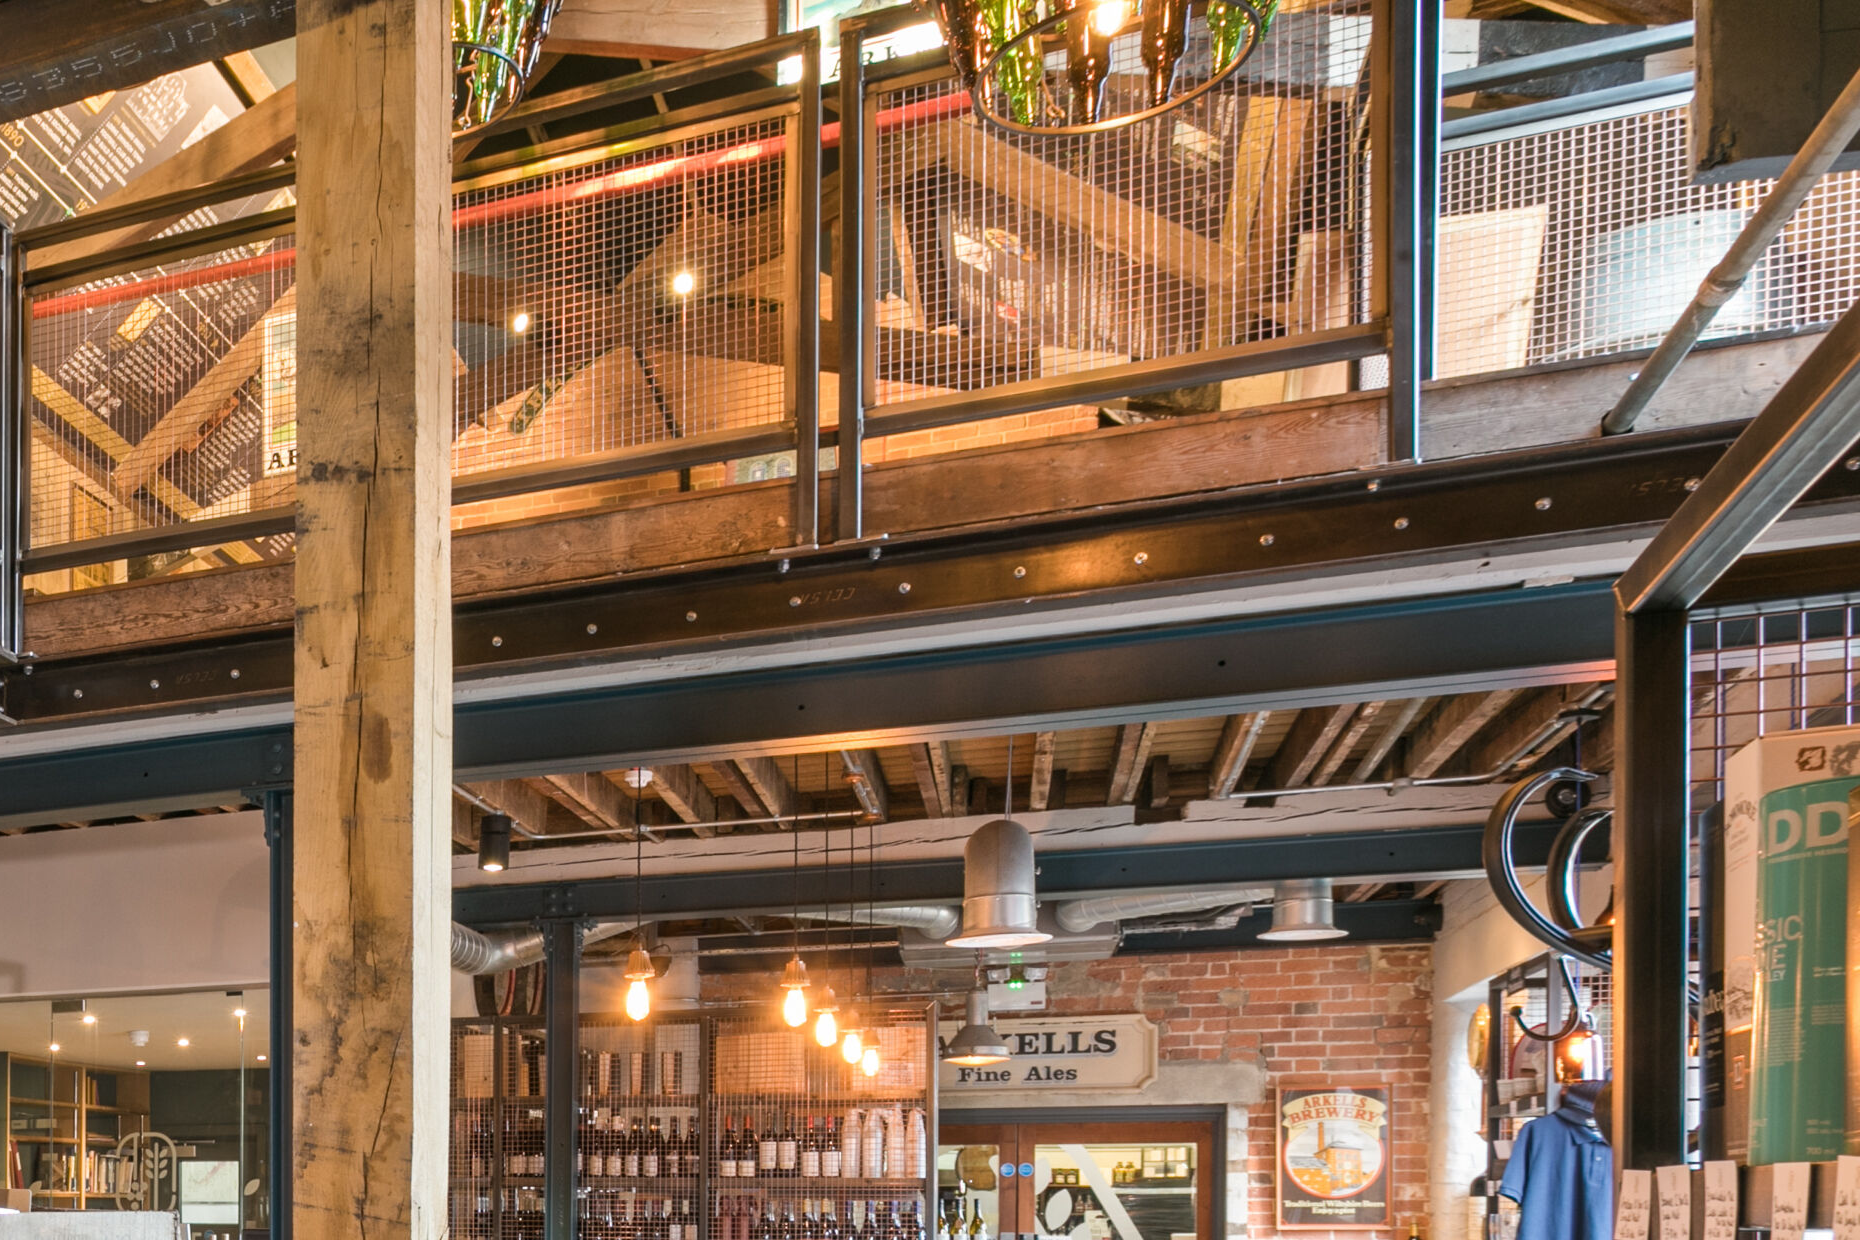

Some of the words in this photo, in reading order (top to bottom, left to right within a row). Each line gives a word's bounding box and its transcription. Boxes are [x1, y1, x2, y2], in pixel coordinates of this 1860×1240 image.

[1, 123, 25, 147] 1890
[938, 1028, 1117, 1056] KELLS
[956, 1067, 1011, 1083] Fine
[1024, 1065, 1078, 1082] Ales
[1290, 1107, 1380, 1124] BREWERY
